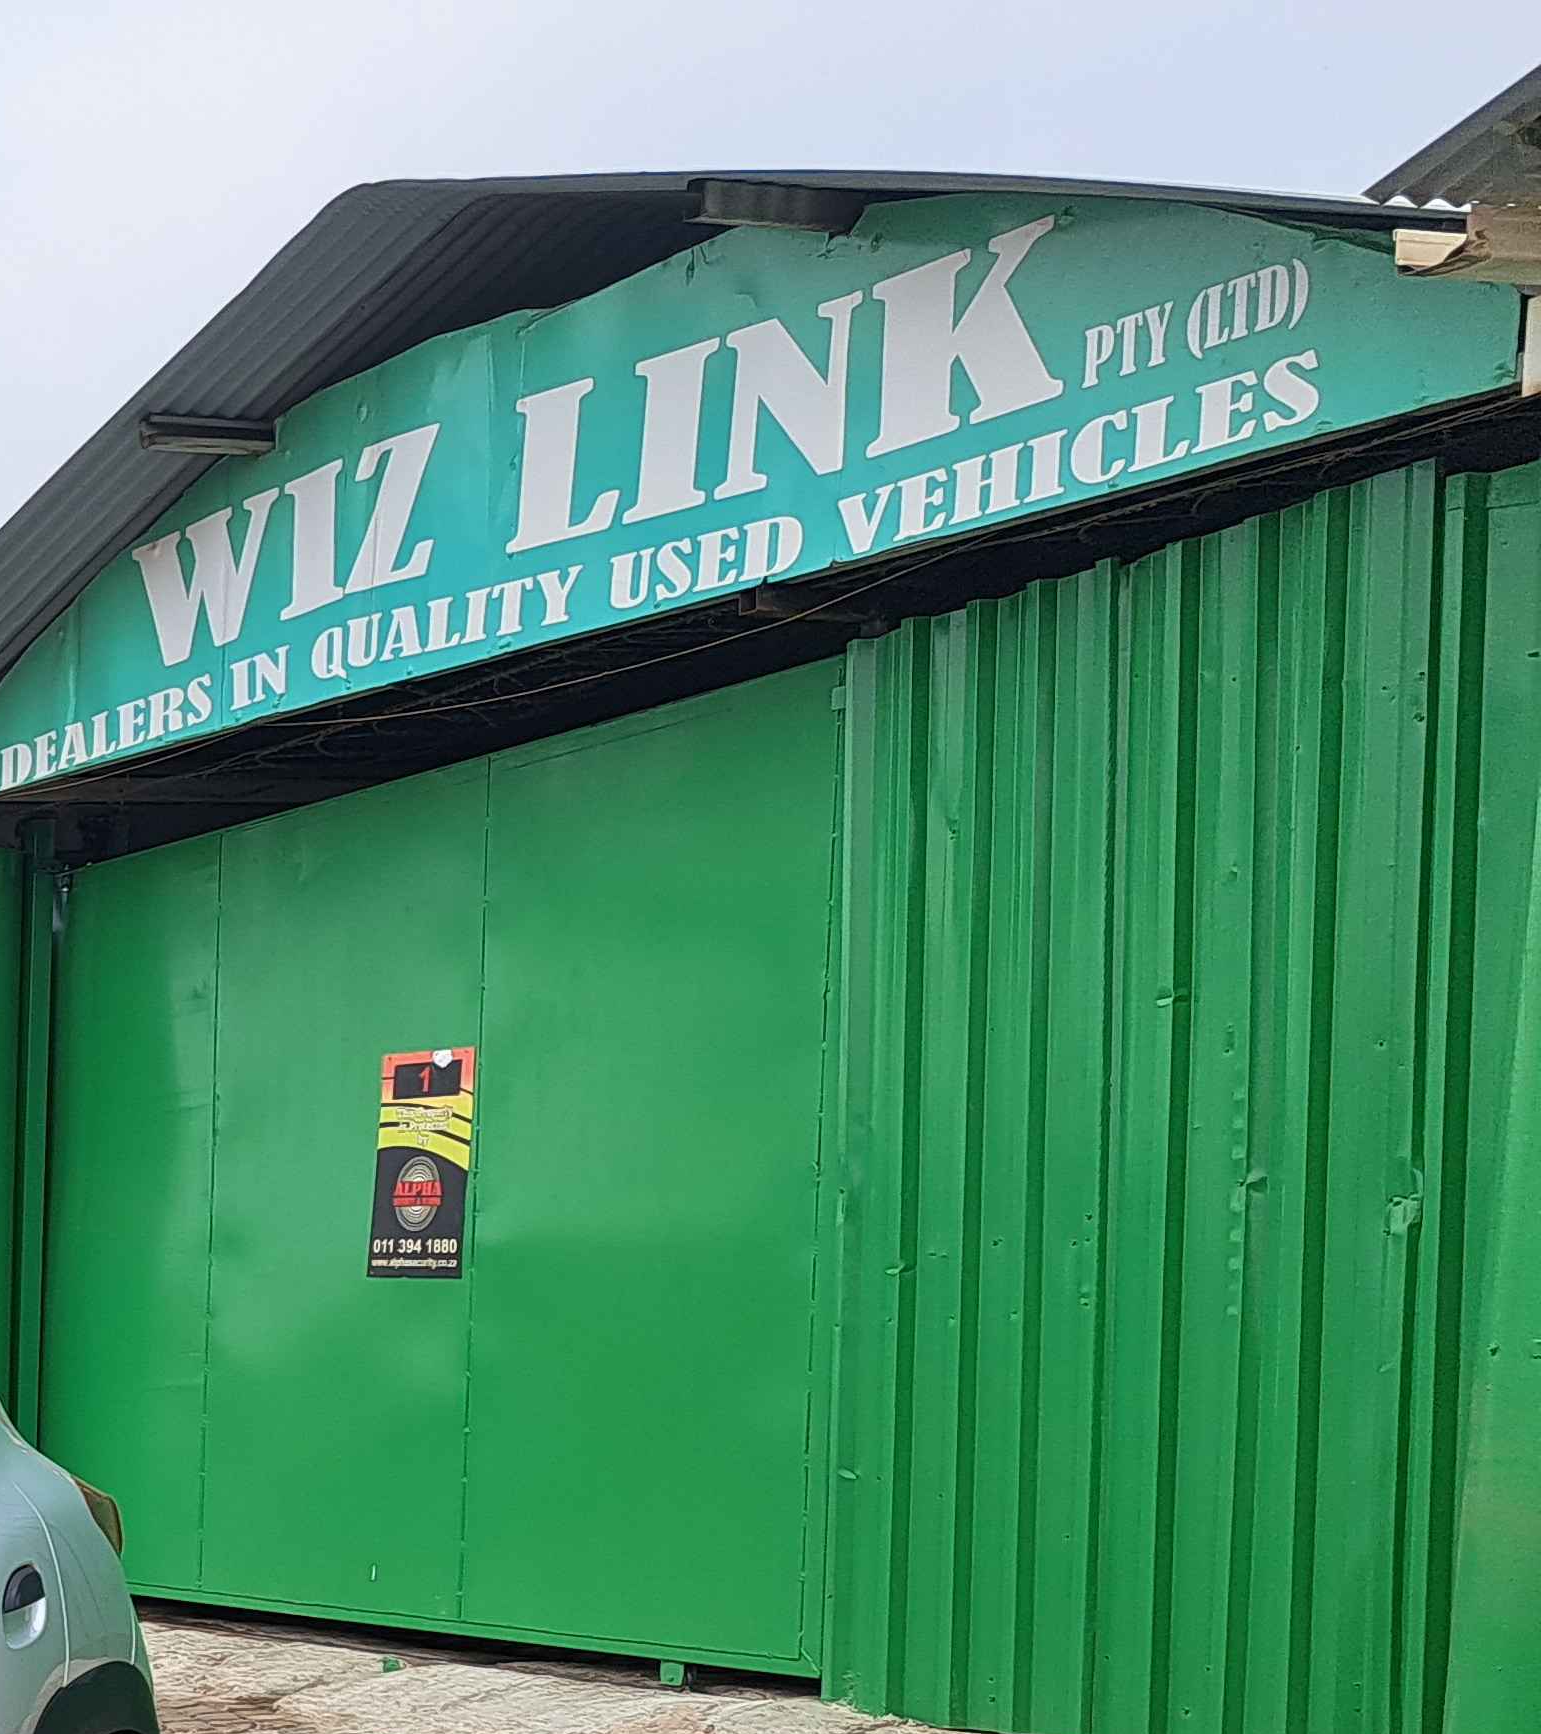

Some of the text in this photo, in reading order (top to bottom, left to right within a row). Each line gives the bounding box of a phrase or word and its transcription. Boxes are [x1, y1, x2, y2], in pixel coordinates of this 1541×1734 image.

[1081, 257, 1312, 389] PTY (LTD)
[131, 214, 1065, 668] WIZ LINK
[229, 642, 288, 707] IN
[309, 565, 585, 682] QUALITY
[609, 515, 805, 610] USED
[834, 347, 1326, 558] VEHICLES
[418, 1066, 431, 1092] 1
[394, 1181, 443, 1197] ALPHA
[373, 1238, 458, 1254] 011 394 1880
